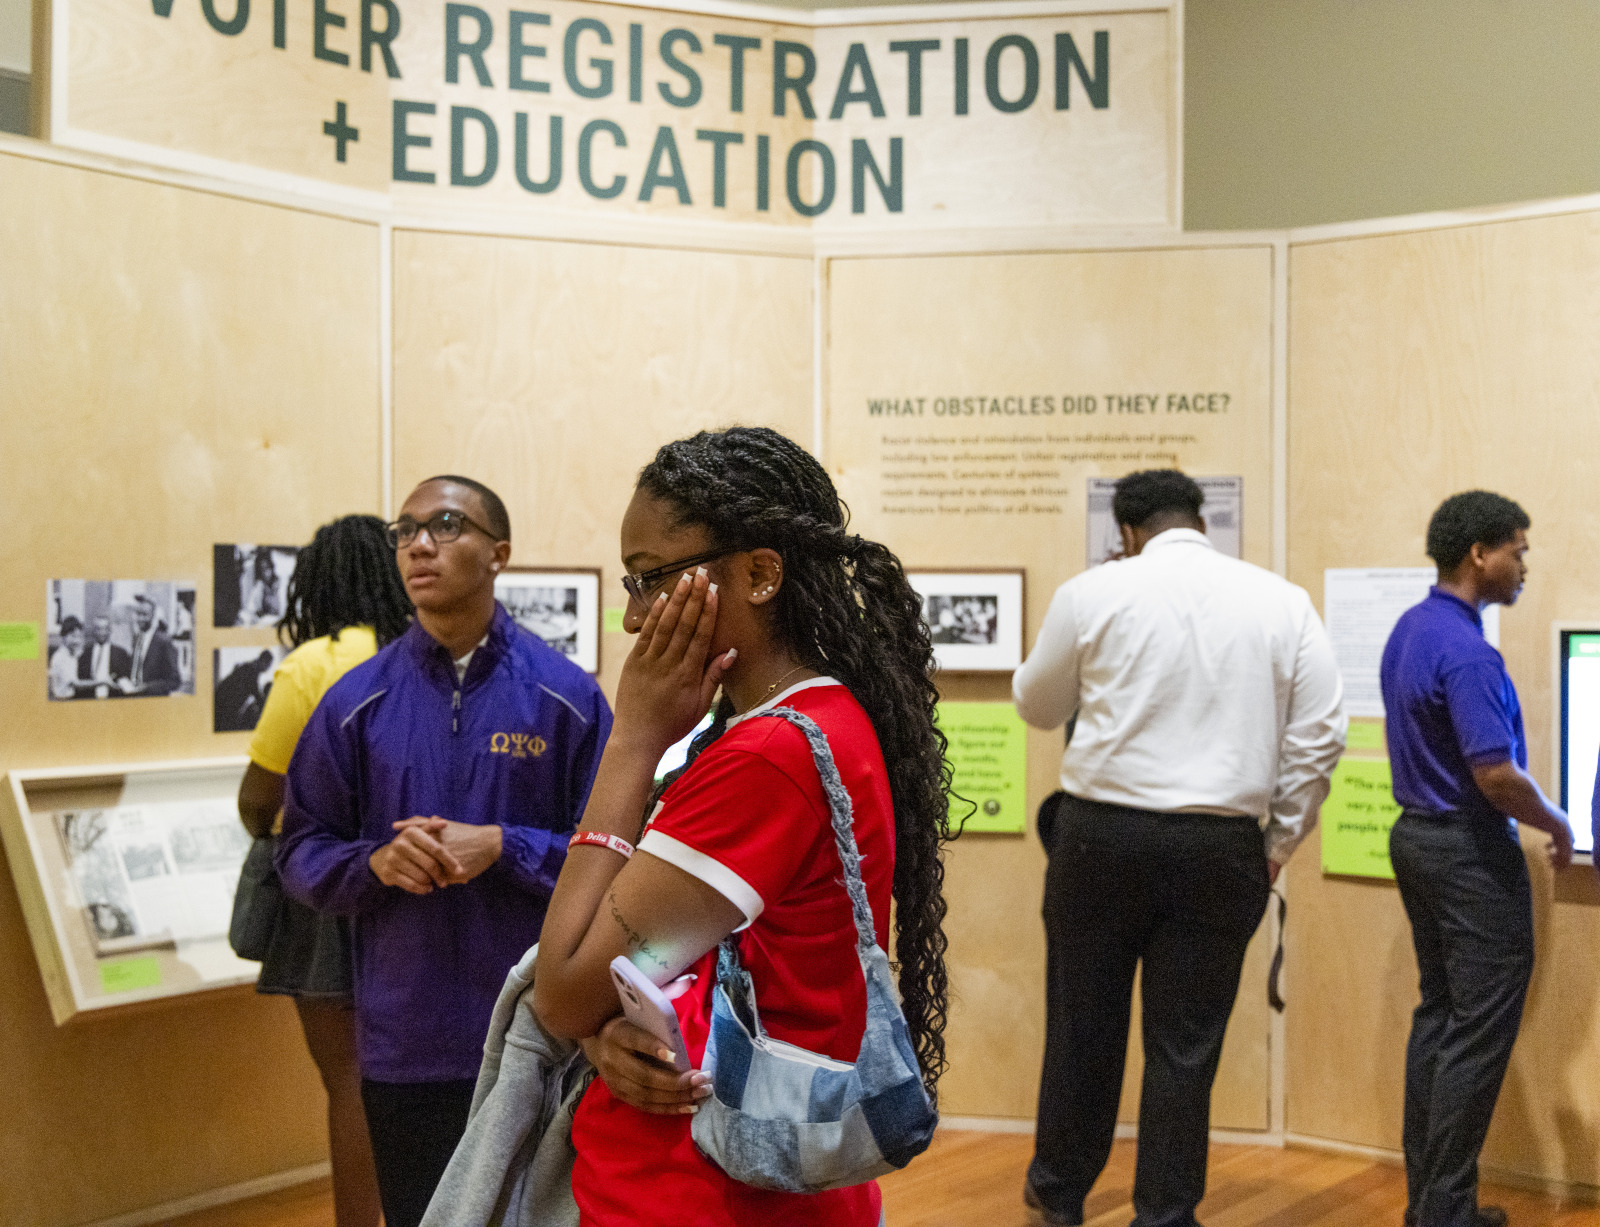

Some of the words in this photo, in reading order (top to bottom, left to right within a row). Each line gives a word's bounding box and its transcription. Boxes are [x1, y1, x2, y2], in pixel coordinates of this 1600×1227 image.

[444, 2, 1110, 121] REGISTRATION
[392, 98, 904, 218] EDUCATION
[867, 397, 927, 417] WHAT
[933, 395, 1056, 417] OBSTACLES
[1063, 394, 1097, 416] DID
[1104, 393, 1157, 415] THEY
[1166, 392, 1231, 414] FACE?
[489, 731, 547, 757] ΩΨΦ
[586, 831, 608, 844] Delta
